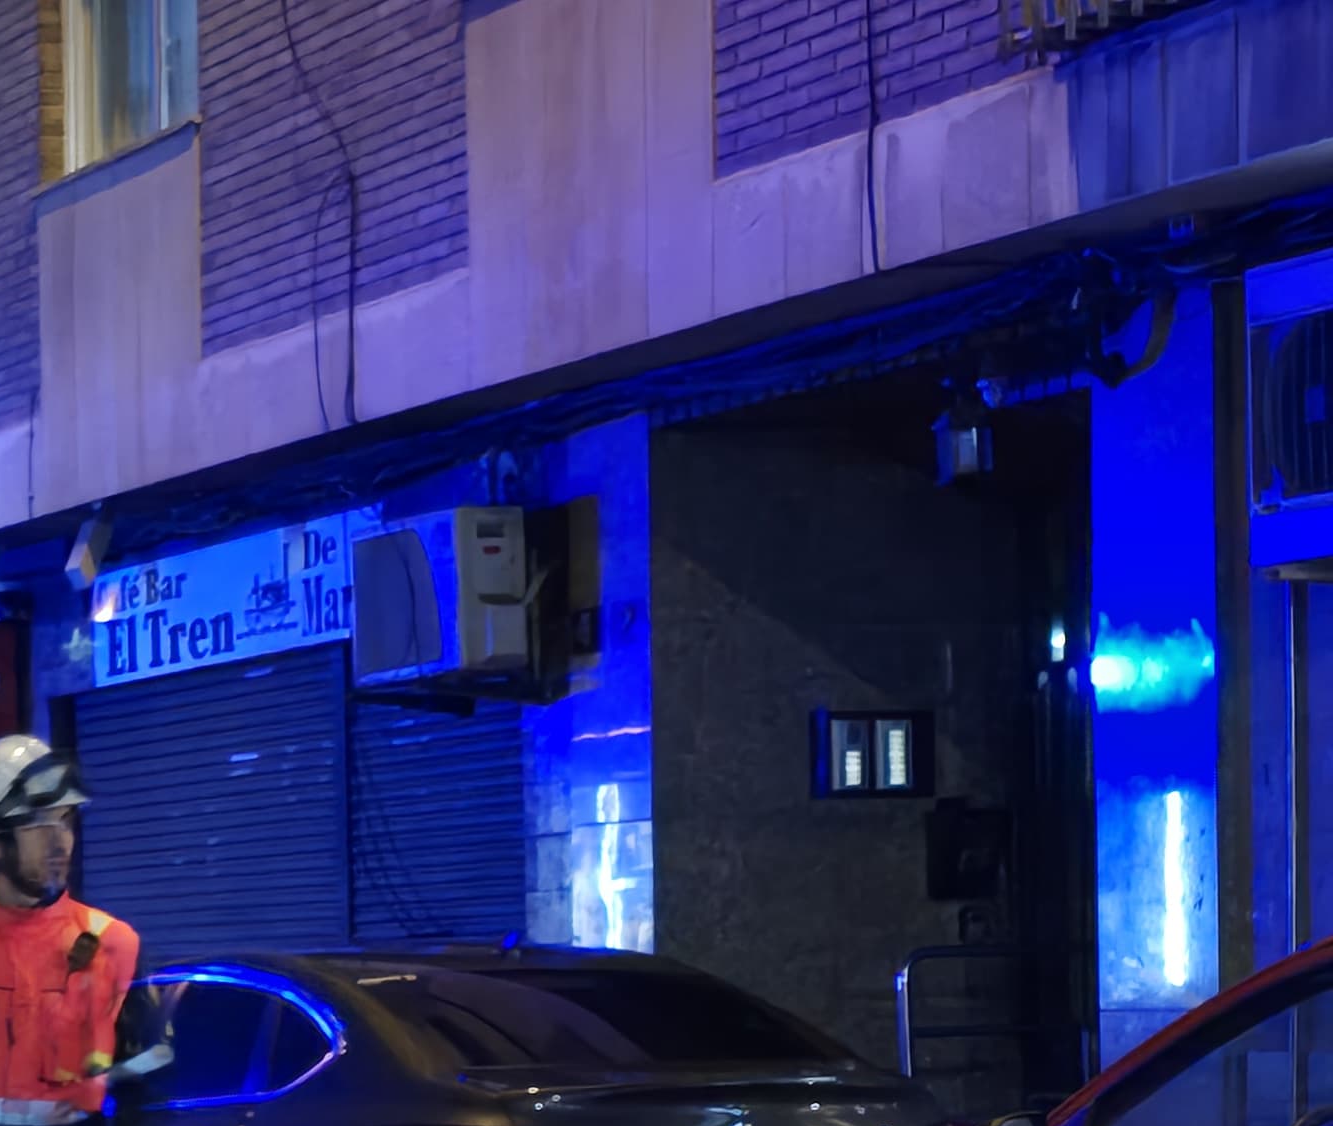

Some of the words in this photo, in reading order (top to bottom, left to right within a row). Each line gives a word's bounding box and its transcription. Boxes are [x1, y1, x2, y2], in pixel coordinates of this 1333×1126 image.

[303, 530, 337, 570] De
[97, 575, 140, 614] Cfé
[145, 568, 187, 606] Bar
[107, 615, 138, 677] El
[143, 608, 235, 668] Tren
